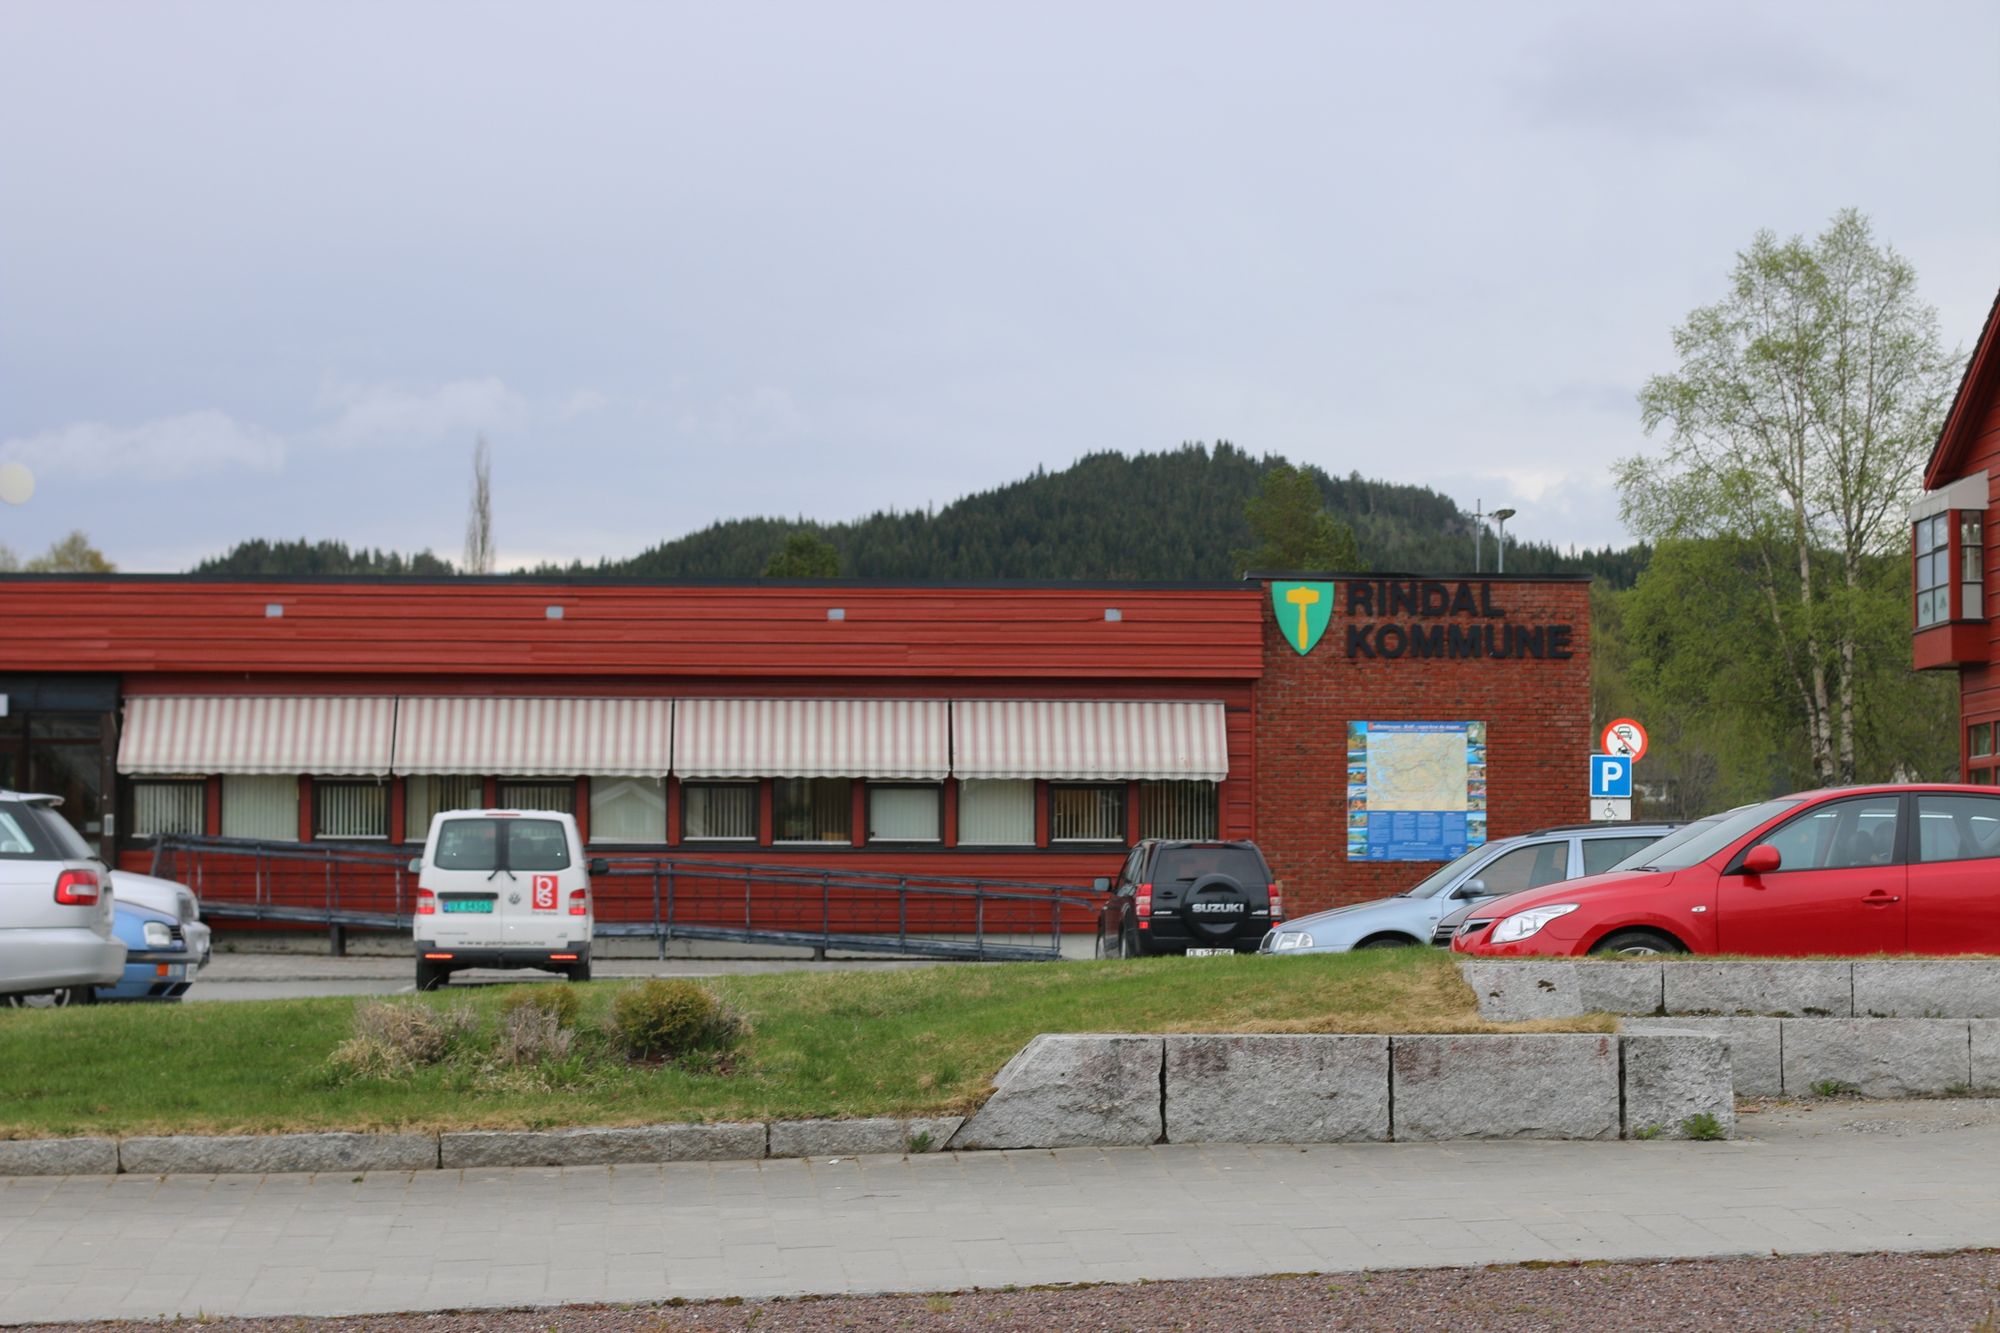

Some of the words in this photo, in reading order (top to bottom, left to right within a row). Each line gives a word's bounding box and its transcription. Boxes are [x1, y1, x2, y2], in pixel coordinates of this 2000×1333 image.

[1348, 582, 1505, 617] RINDAL
[1348, 624, 1573, 659] KOMMUNE
[1602, 761, 1623, 792] P
[1192, 903, 1244, 913] SUZUKI
